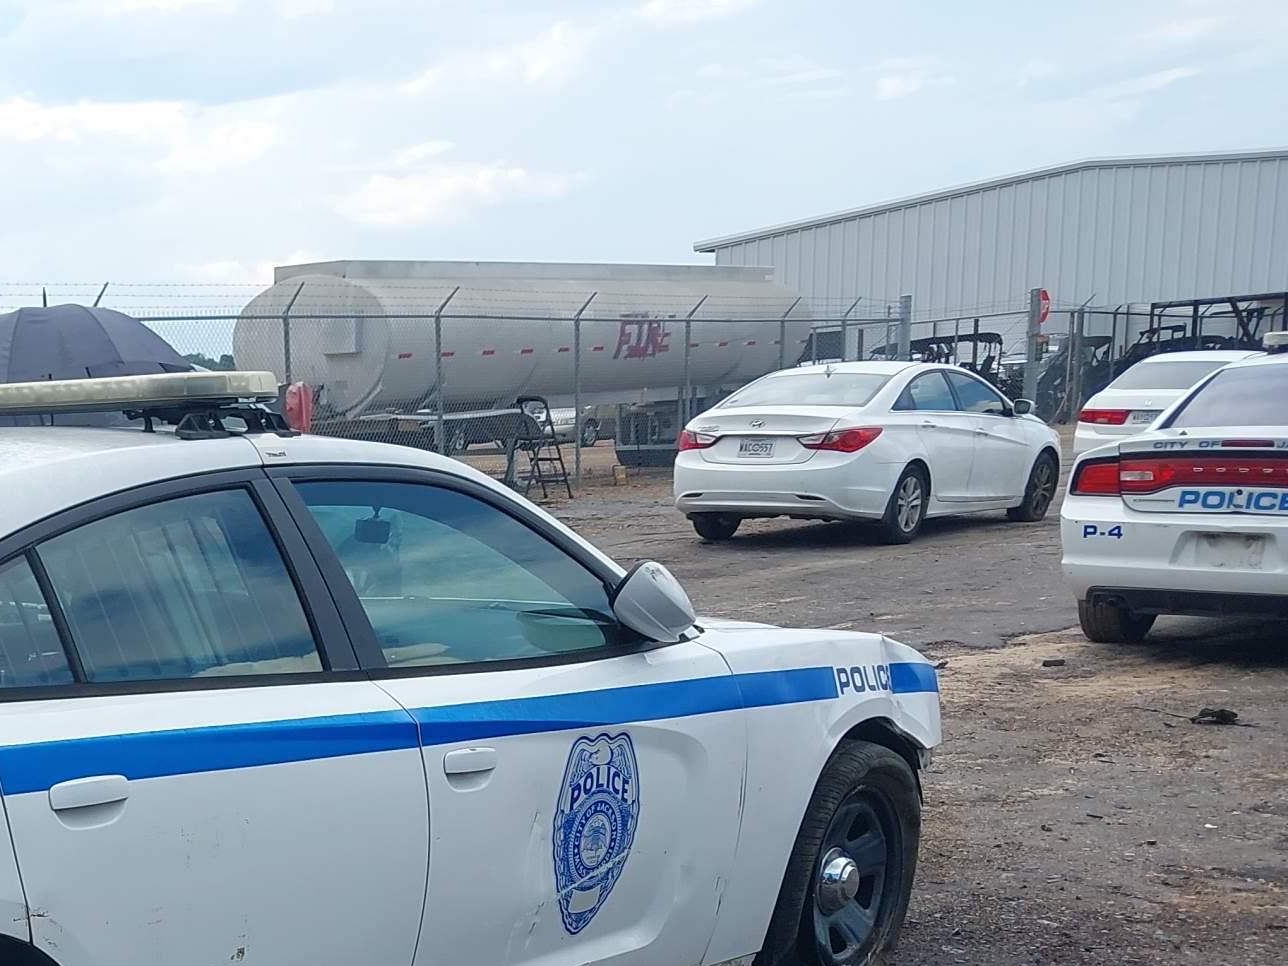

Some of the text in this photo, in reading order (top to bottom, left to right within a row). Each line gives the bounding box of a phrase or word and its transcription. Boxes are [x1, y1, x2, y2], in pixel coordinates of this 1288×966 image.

[1153, 440, 1189, 449] CITY
[1199, 440, 1221, 449] OF
[1083, 524, 1123, 539] P-4
[569, 766, 630, 811] POLICE
[574, 802, 617, 845] CITY OF JACKSON
